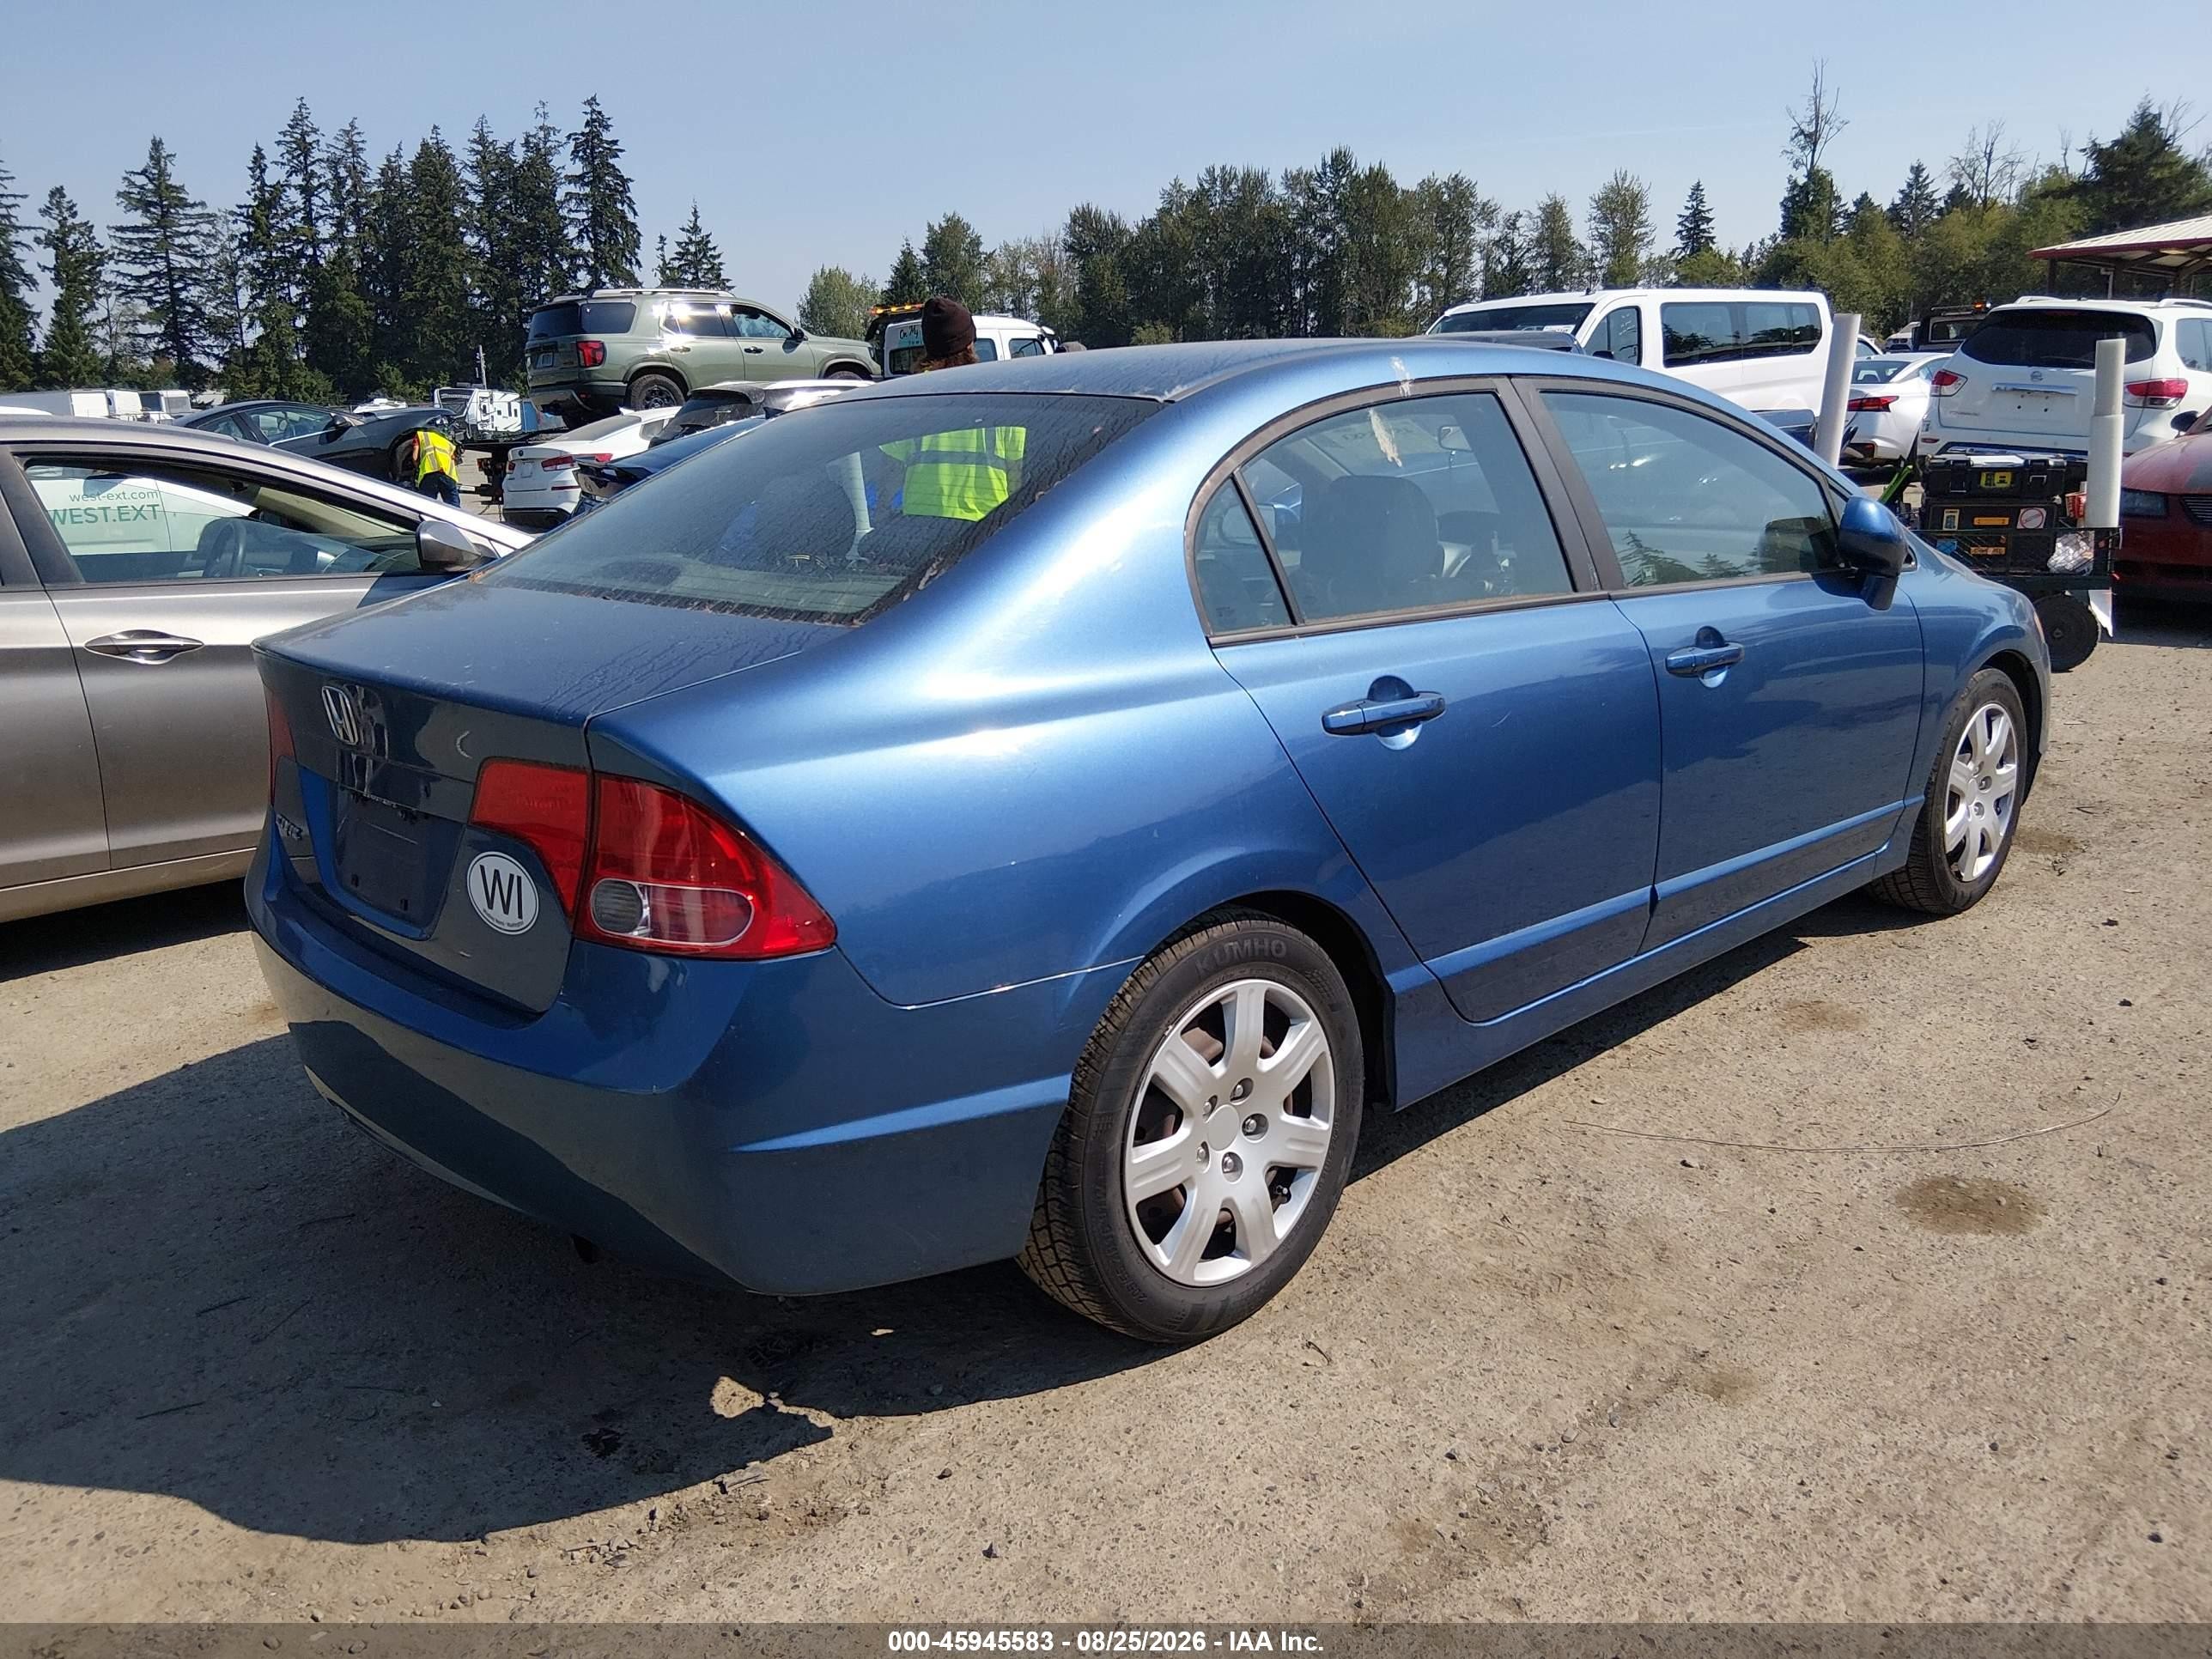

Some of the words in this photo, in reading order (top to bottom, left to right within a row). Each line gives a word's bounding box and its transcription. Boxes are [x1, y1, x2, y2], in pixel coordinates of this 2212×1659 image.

[70, 490, 159, 502] west-ext.com
[52, 503, 160, 525] WEST.EXT
[480, 864, 523, 920] WI
[1194, 938, 1287, 976] KUMHO
